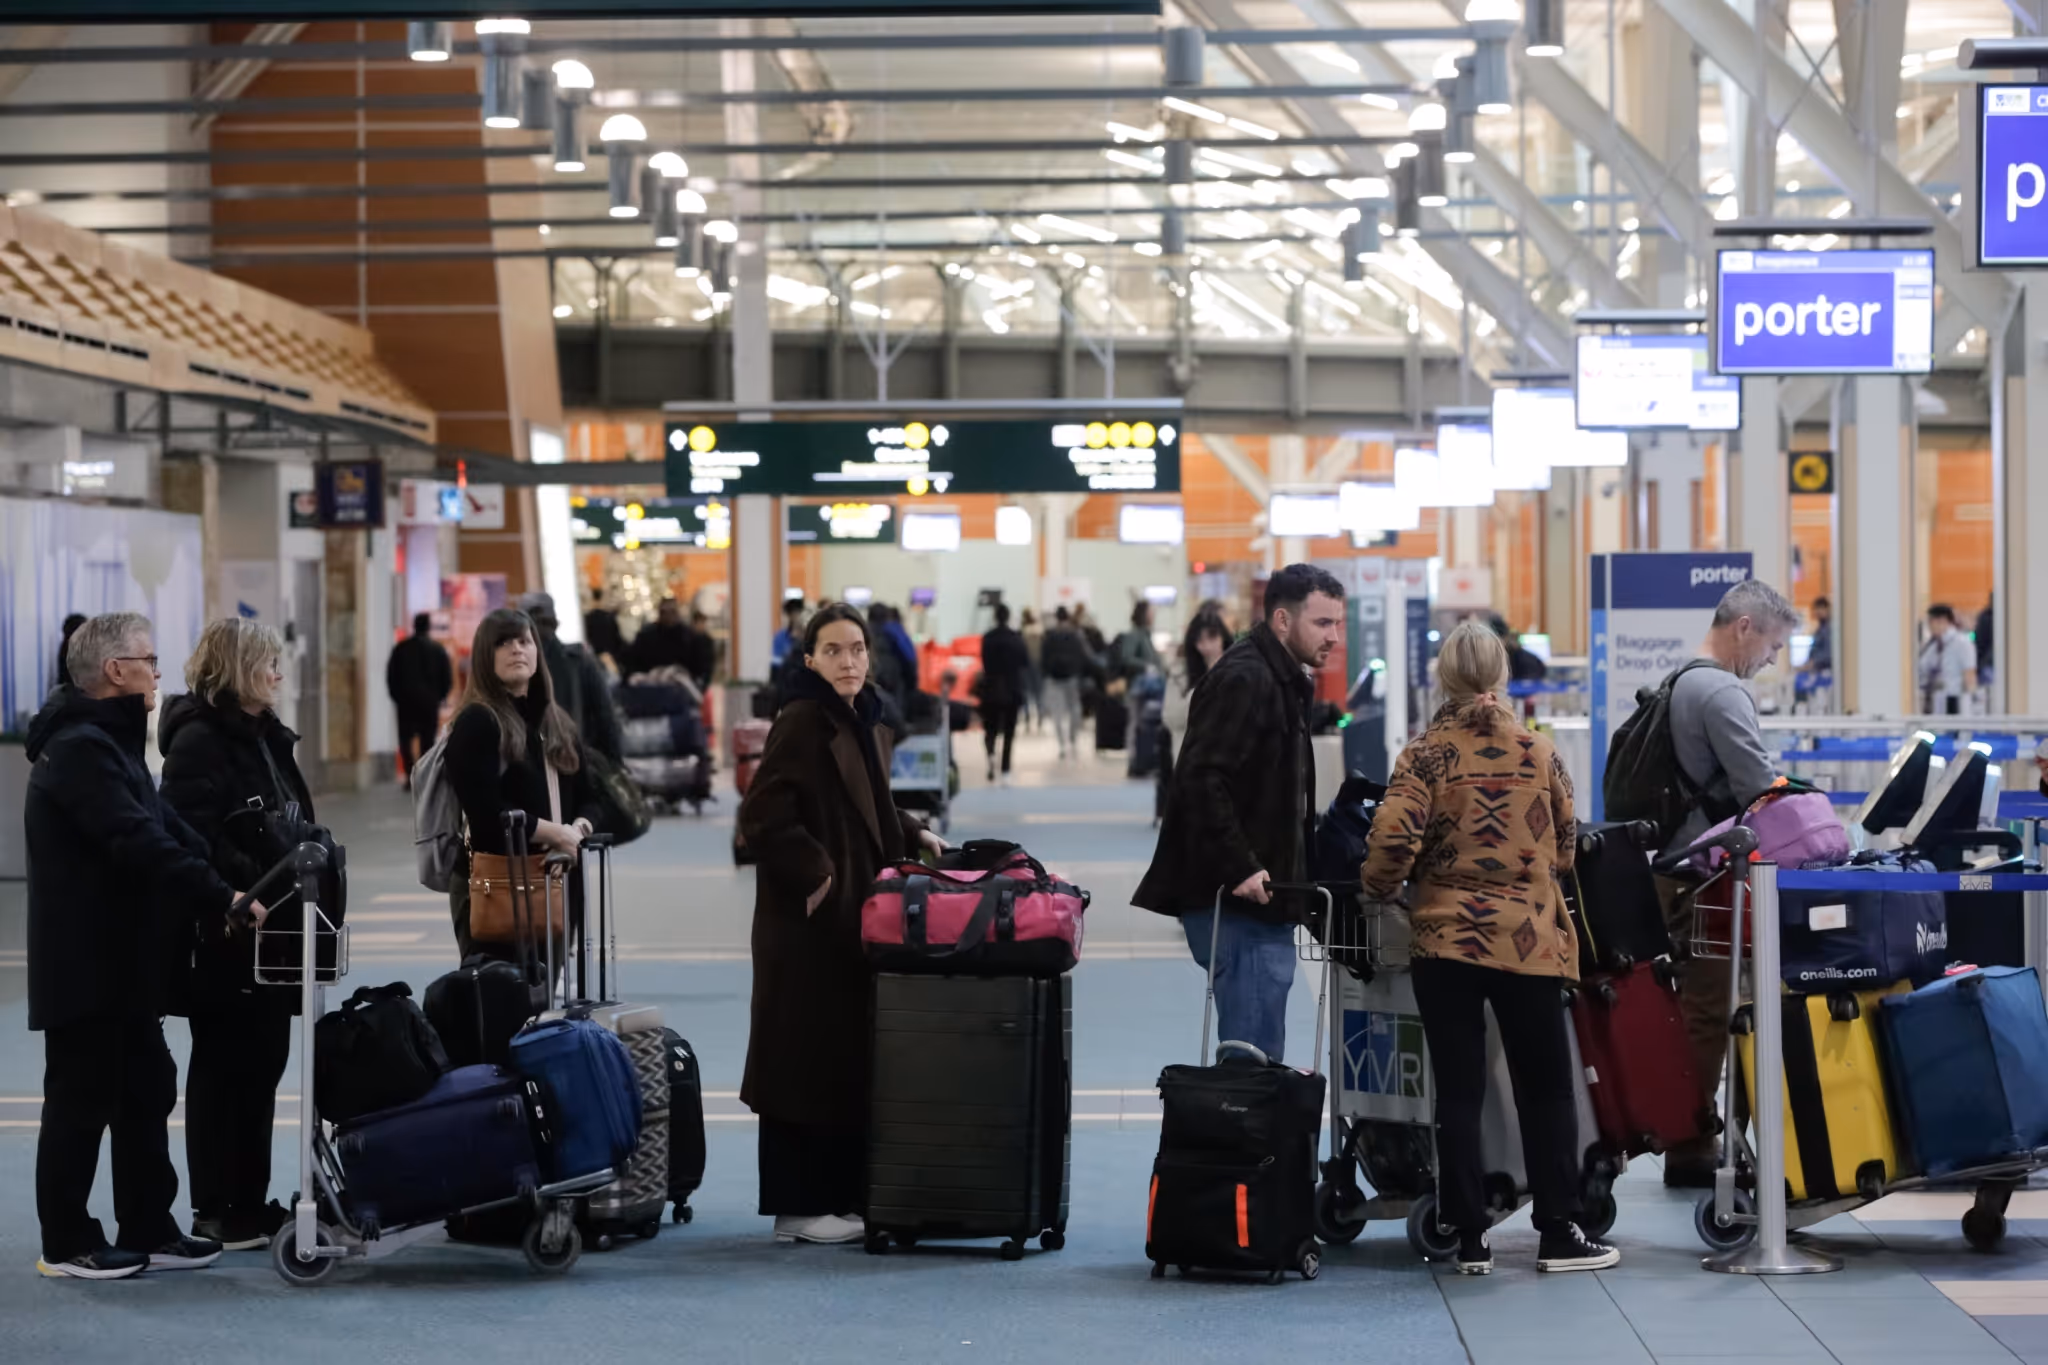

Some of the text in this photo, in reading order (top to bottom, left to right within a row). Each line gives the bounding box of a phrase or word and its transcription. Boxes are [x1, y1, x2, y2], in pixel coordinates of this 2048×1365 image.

[1734, 293, 1882, 347] porter
[1690, 565, 1748, 587] porter
[1616, 634, 1683, 651] Baggage
[1616, 654, 1652, 671] Drop
[1960, 880, 1992, 890] YVR
[1800, 966, 1877, 981] oneills.com
[1343, 1045, 1424, 1098] YVR
